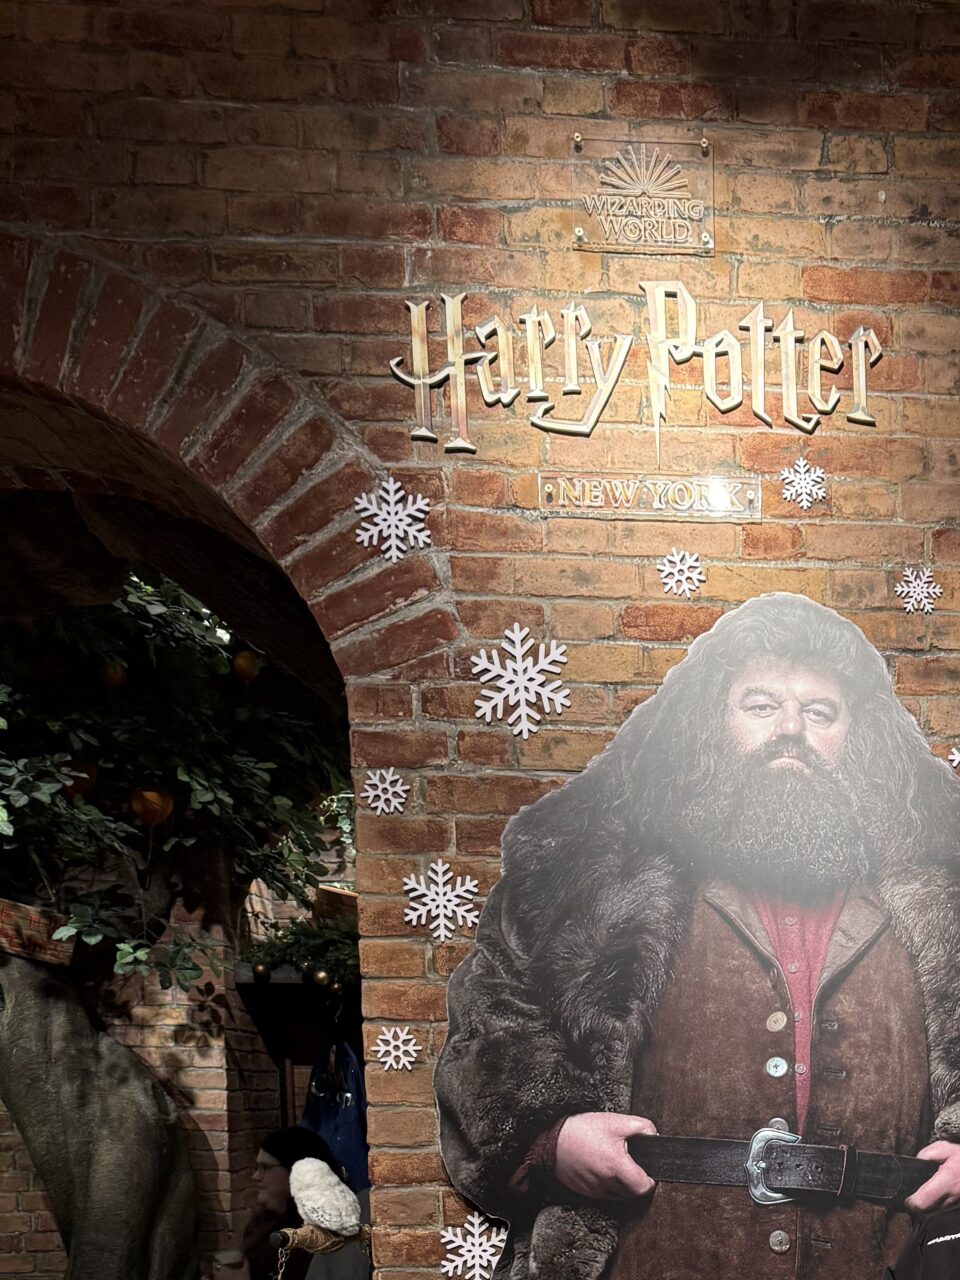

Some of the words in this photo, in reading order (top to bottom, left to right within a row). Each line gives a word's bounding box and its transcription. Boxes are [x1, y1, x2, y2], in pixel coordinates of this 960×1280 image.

[583, 195, 704, 221] WIZARDING
[597, 217, 692, 243] WORLD
[390, 292, 634, 454] Harry
[639, 280, 884, 467] Potter
[558, 478, 640, 507] NEW
[646, 480, 744, 512] YORK
